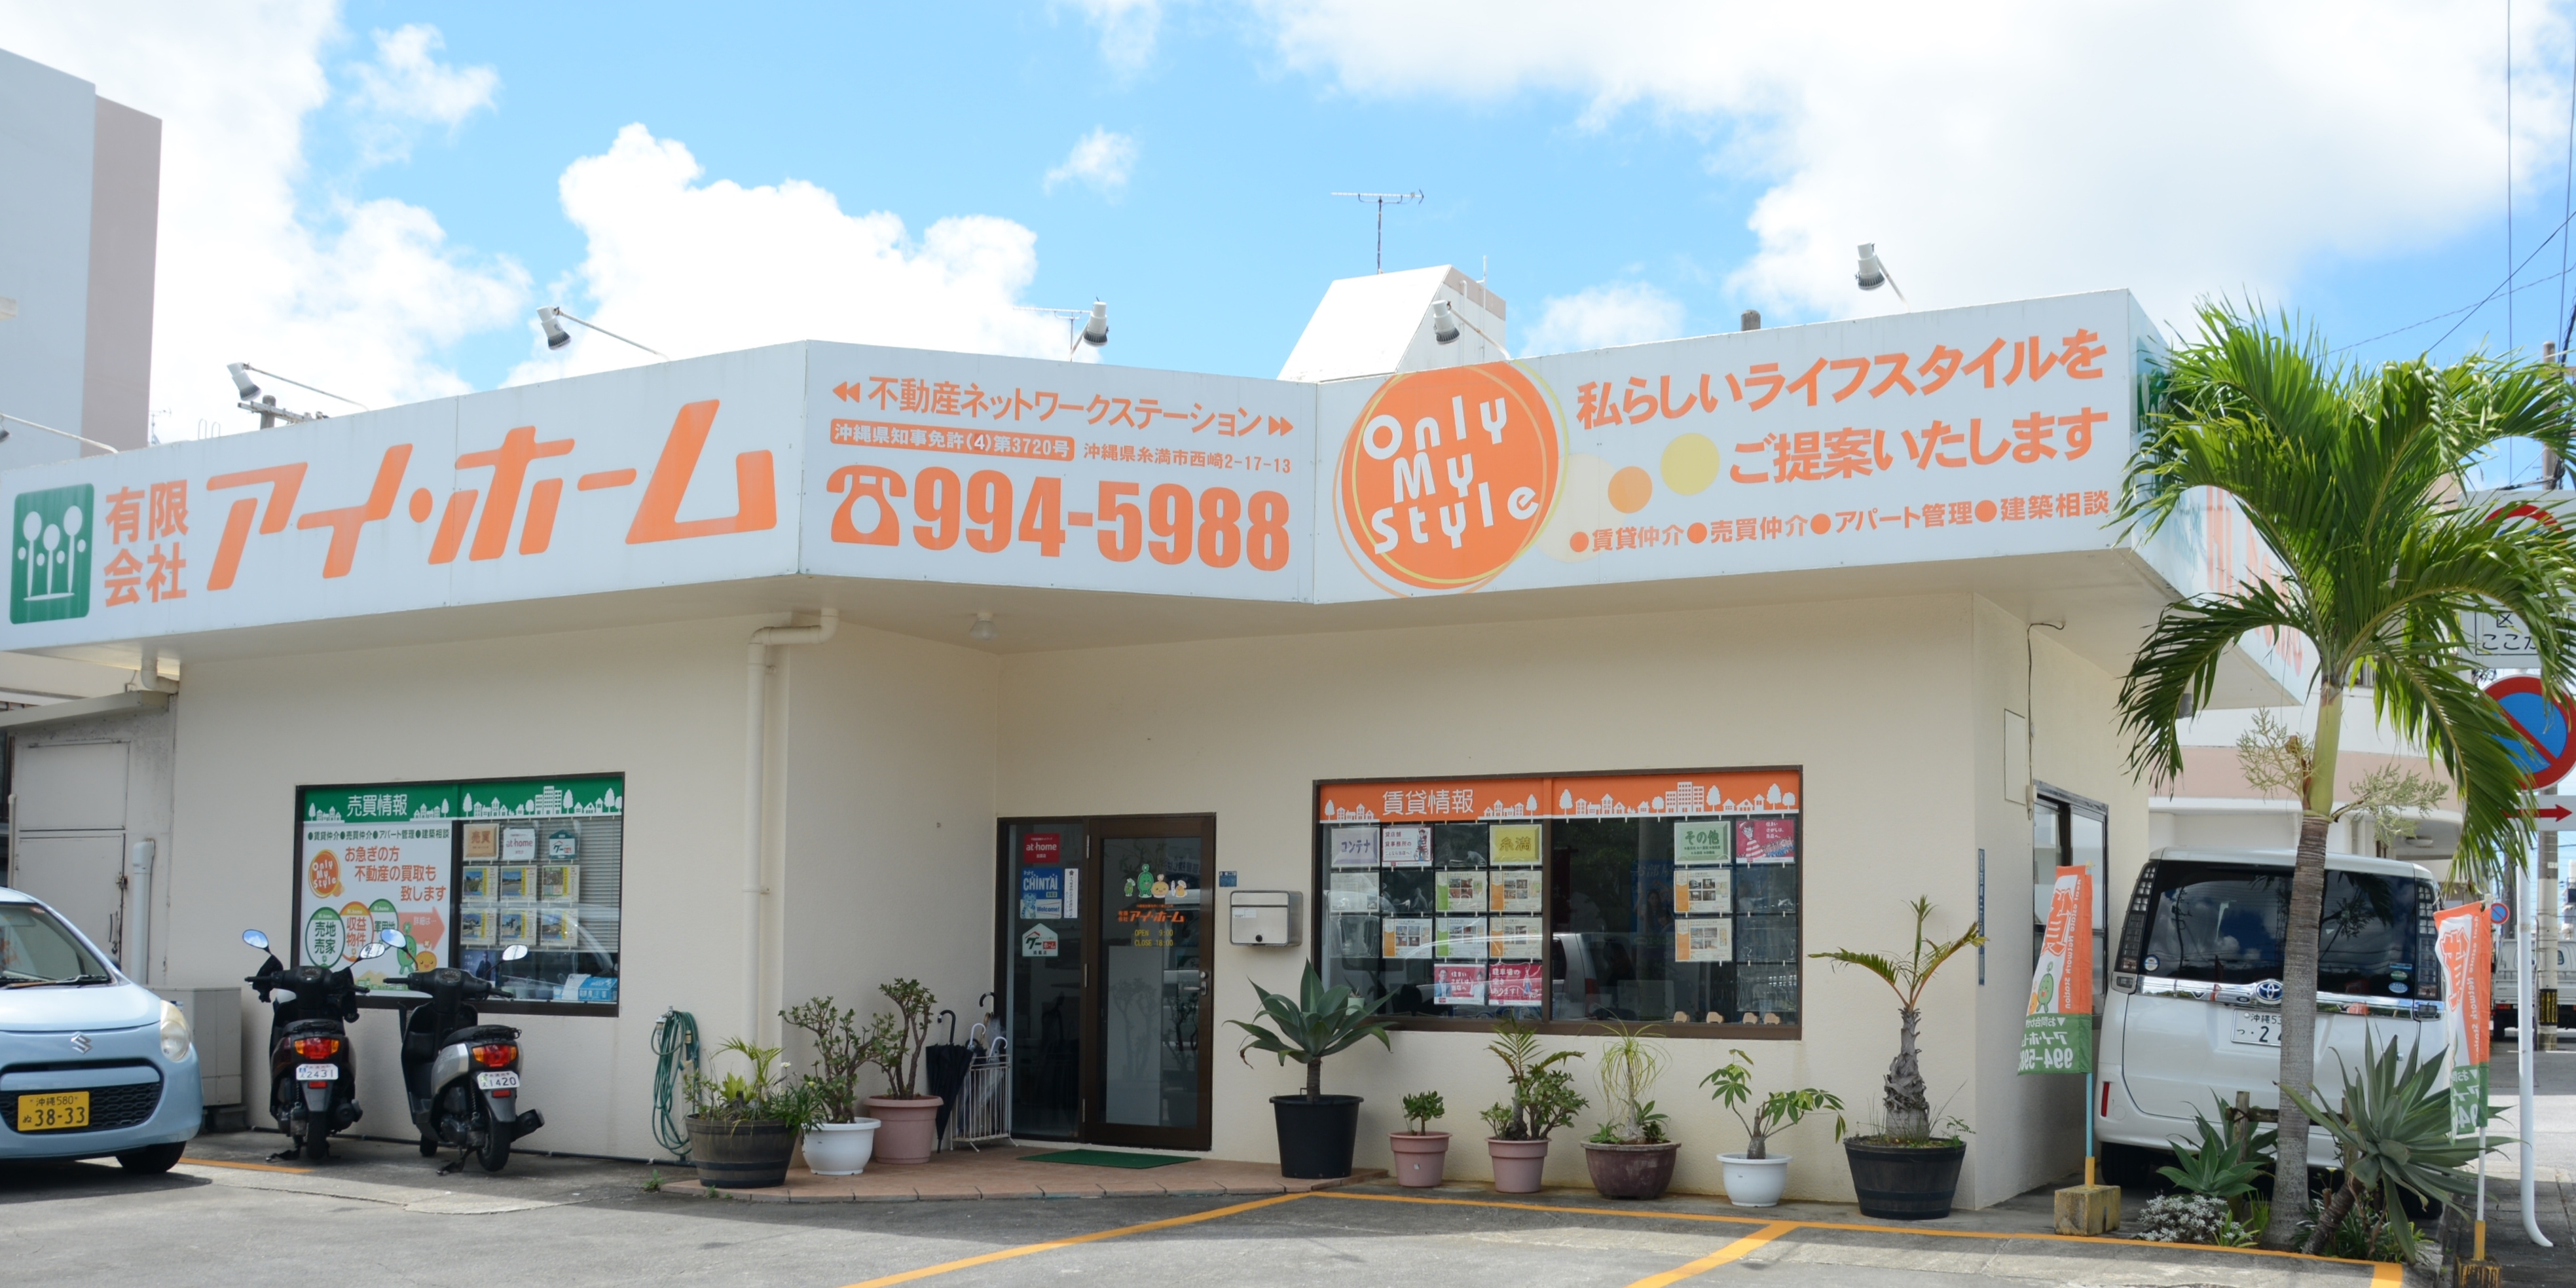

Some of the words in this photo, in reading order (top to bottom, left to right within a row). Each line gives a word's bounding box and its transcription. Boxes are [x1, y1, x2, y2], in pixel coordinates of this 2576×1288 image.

[1576, 329, 2107, 430] 私らしいライフスタイルを
[868, 377, 1262, 437] 不動産ネットワークステーション
[1363, 395, 1507, 460] Only
[835, 423, 1070, 457] 沖縄県知事免許(4)第3720号
[1730, 407, 2108, 483] ご提案いたします
[1084, 443, 1291, 473] 沖縄県糸満市西崎2-17-13
[1393, 452, 1473, 503] My
[206, 399, 777, 591] アイ・ホーム
[105, 479, 189, 545] 有限
[913, 466, 1290, 572] 994-5988
[1371, 481, 1539, 555] Style
[1592, 524, 1685, 551] 賃貸仲介
[1710, 515, 1809, 544] 売買仲介
[1835, 502, 1974, 533] アパート管理
[2000, 490, 2110, 521] 建築相談
[103, 542, 187, 608] 会社
[347, 794, 407, 817] 売買情報
[1382, 788, 1474, 816] 賃貸情報
[1341, 839, 1371, 854] コンテナ
[1500, 837, 1532, 852] 糸満
[1685, 830, 1720, 845] その他
[345, 845, 400, 862] お急ぎの方
[355, 864, 437, 882] 不動産の買取も
[400, 885, 447, 902] 致します
[314, 921, 336, 938] 売地
[346, 916, 367, 932] 収益
[314, 938, 336, 954] 売家
[346, 932, 366, 947] 物件
[306, 1069, 333, 1078] 2431
[490, 1076, 517, 1086] 1420
[36, 1095, 74, 1107] 沖縄580
[23, 1114, 32, 1123] ぬ
[35, 1107, 85, 1127] 38-33
